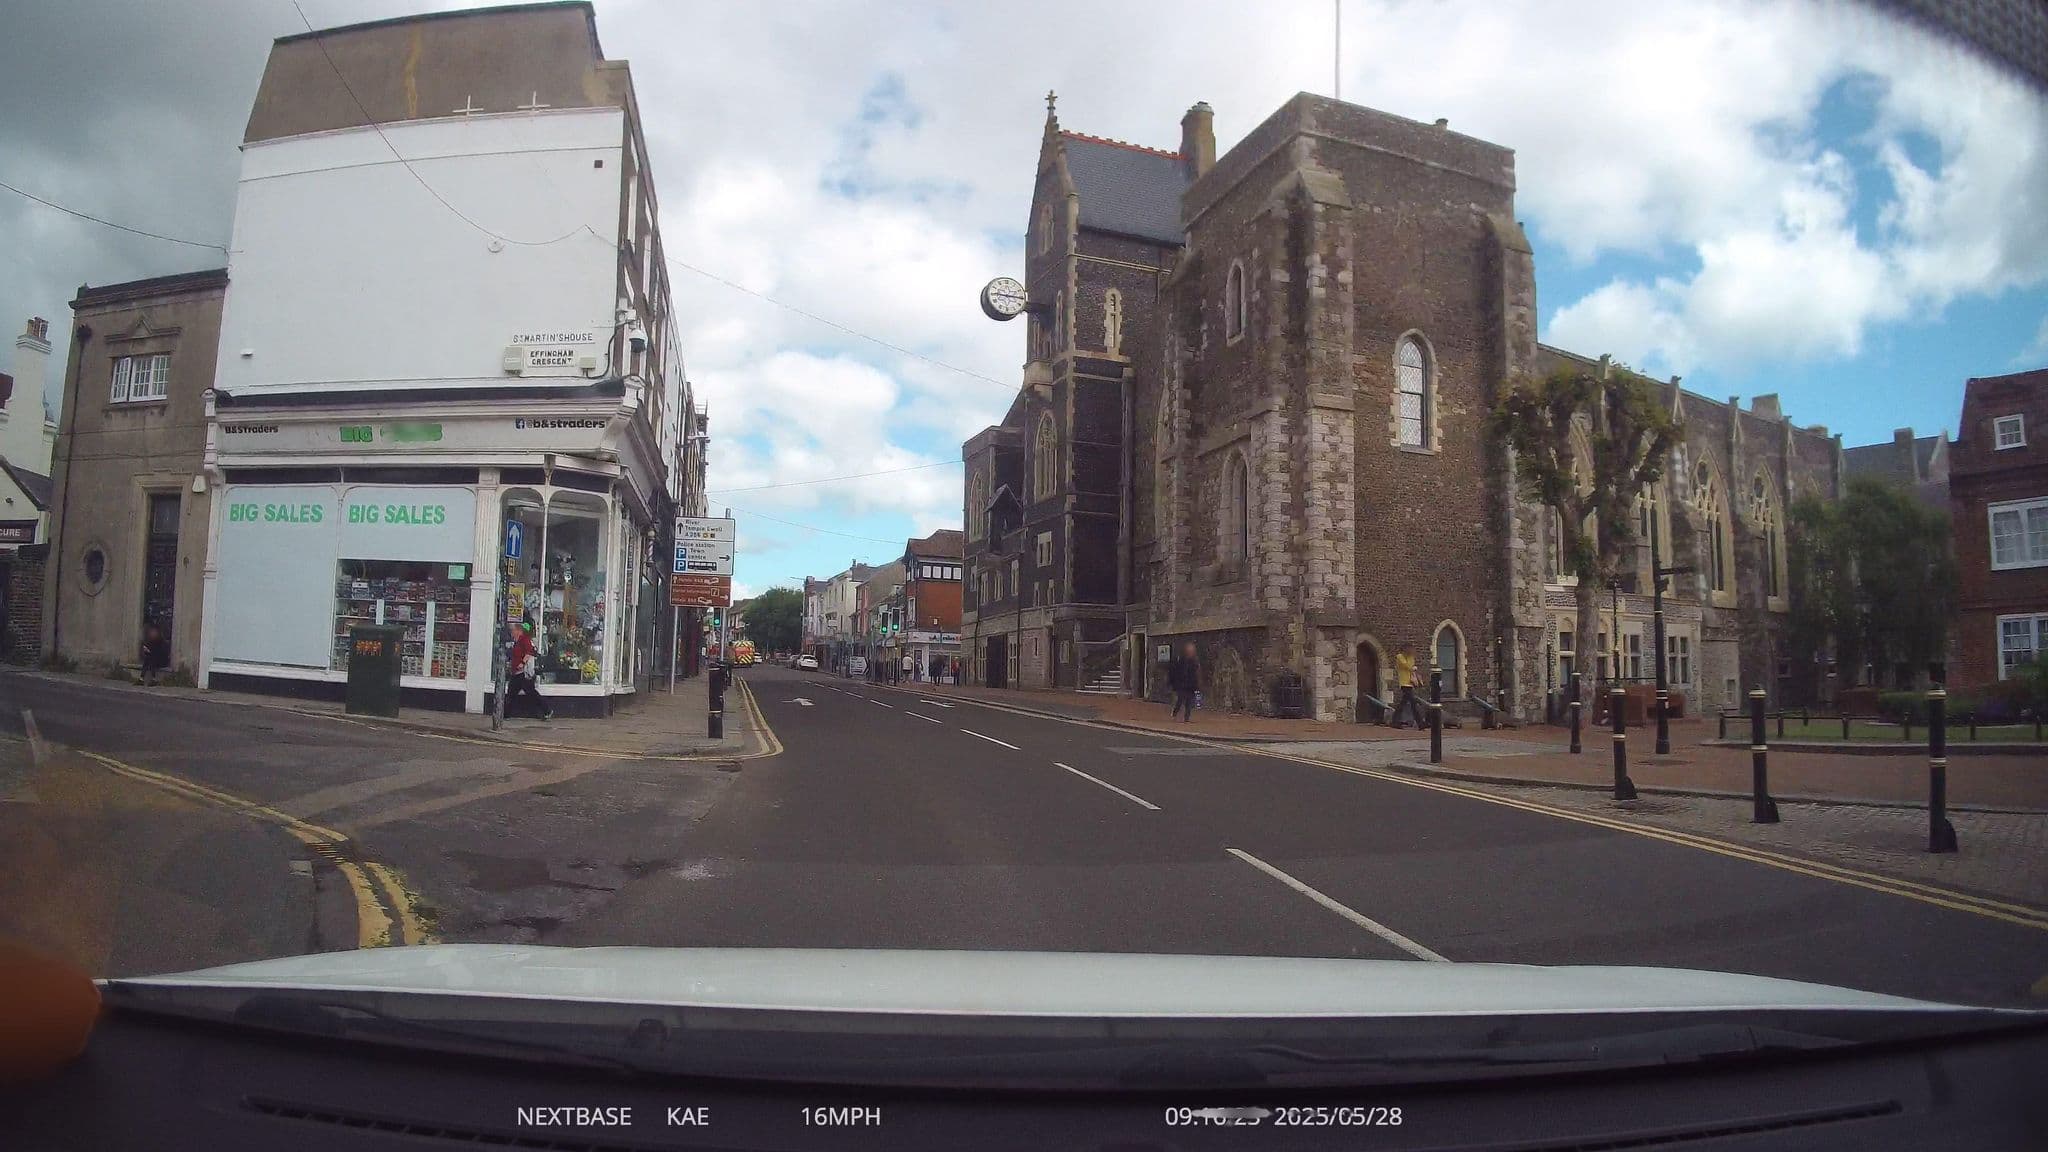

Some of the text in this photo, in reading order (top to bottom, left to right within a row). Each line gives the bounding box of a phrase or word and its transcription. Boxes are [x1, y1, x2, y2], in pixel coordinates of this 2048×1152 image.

[530, 350, 574, 358] EFFINGHAM
[229, 503, 324, 522] BIG SALES
[348, 505, 446, 524] BIG SALES
